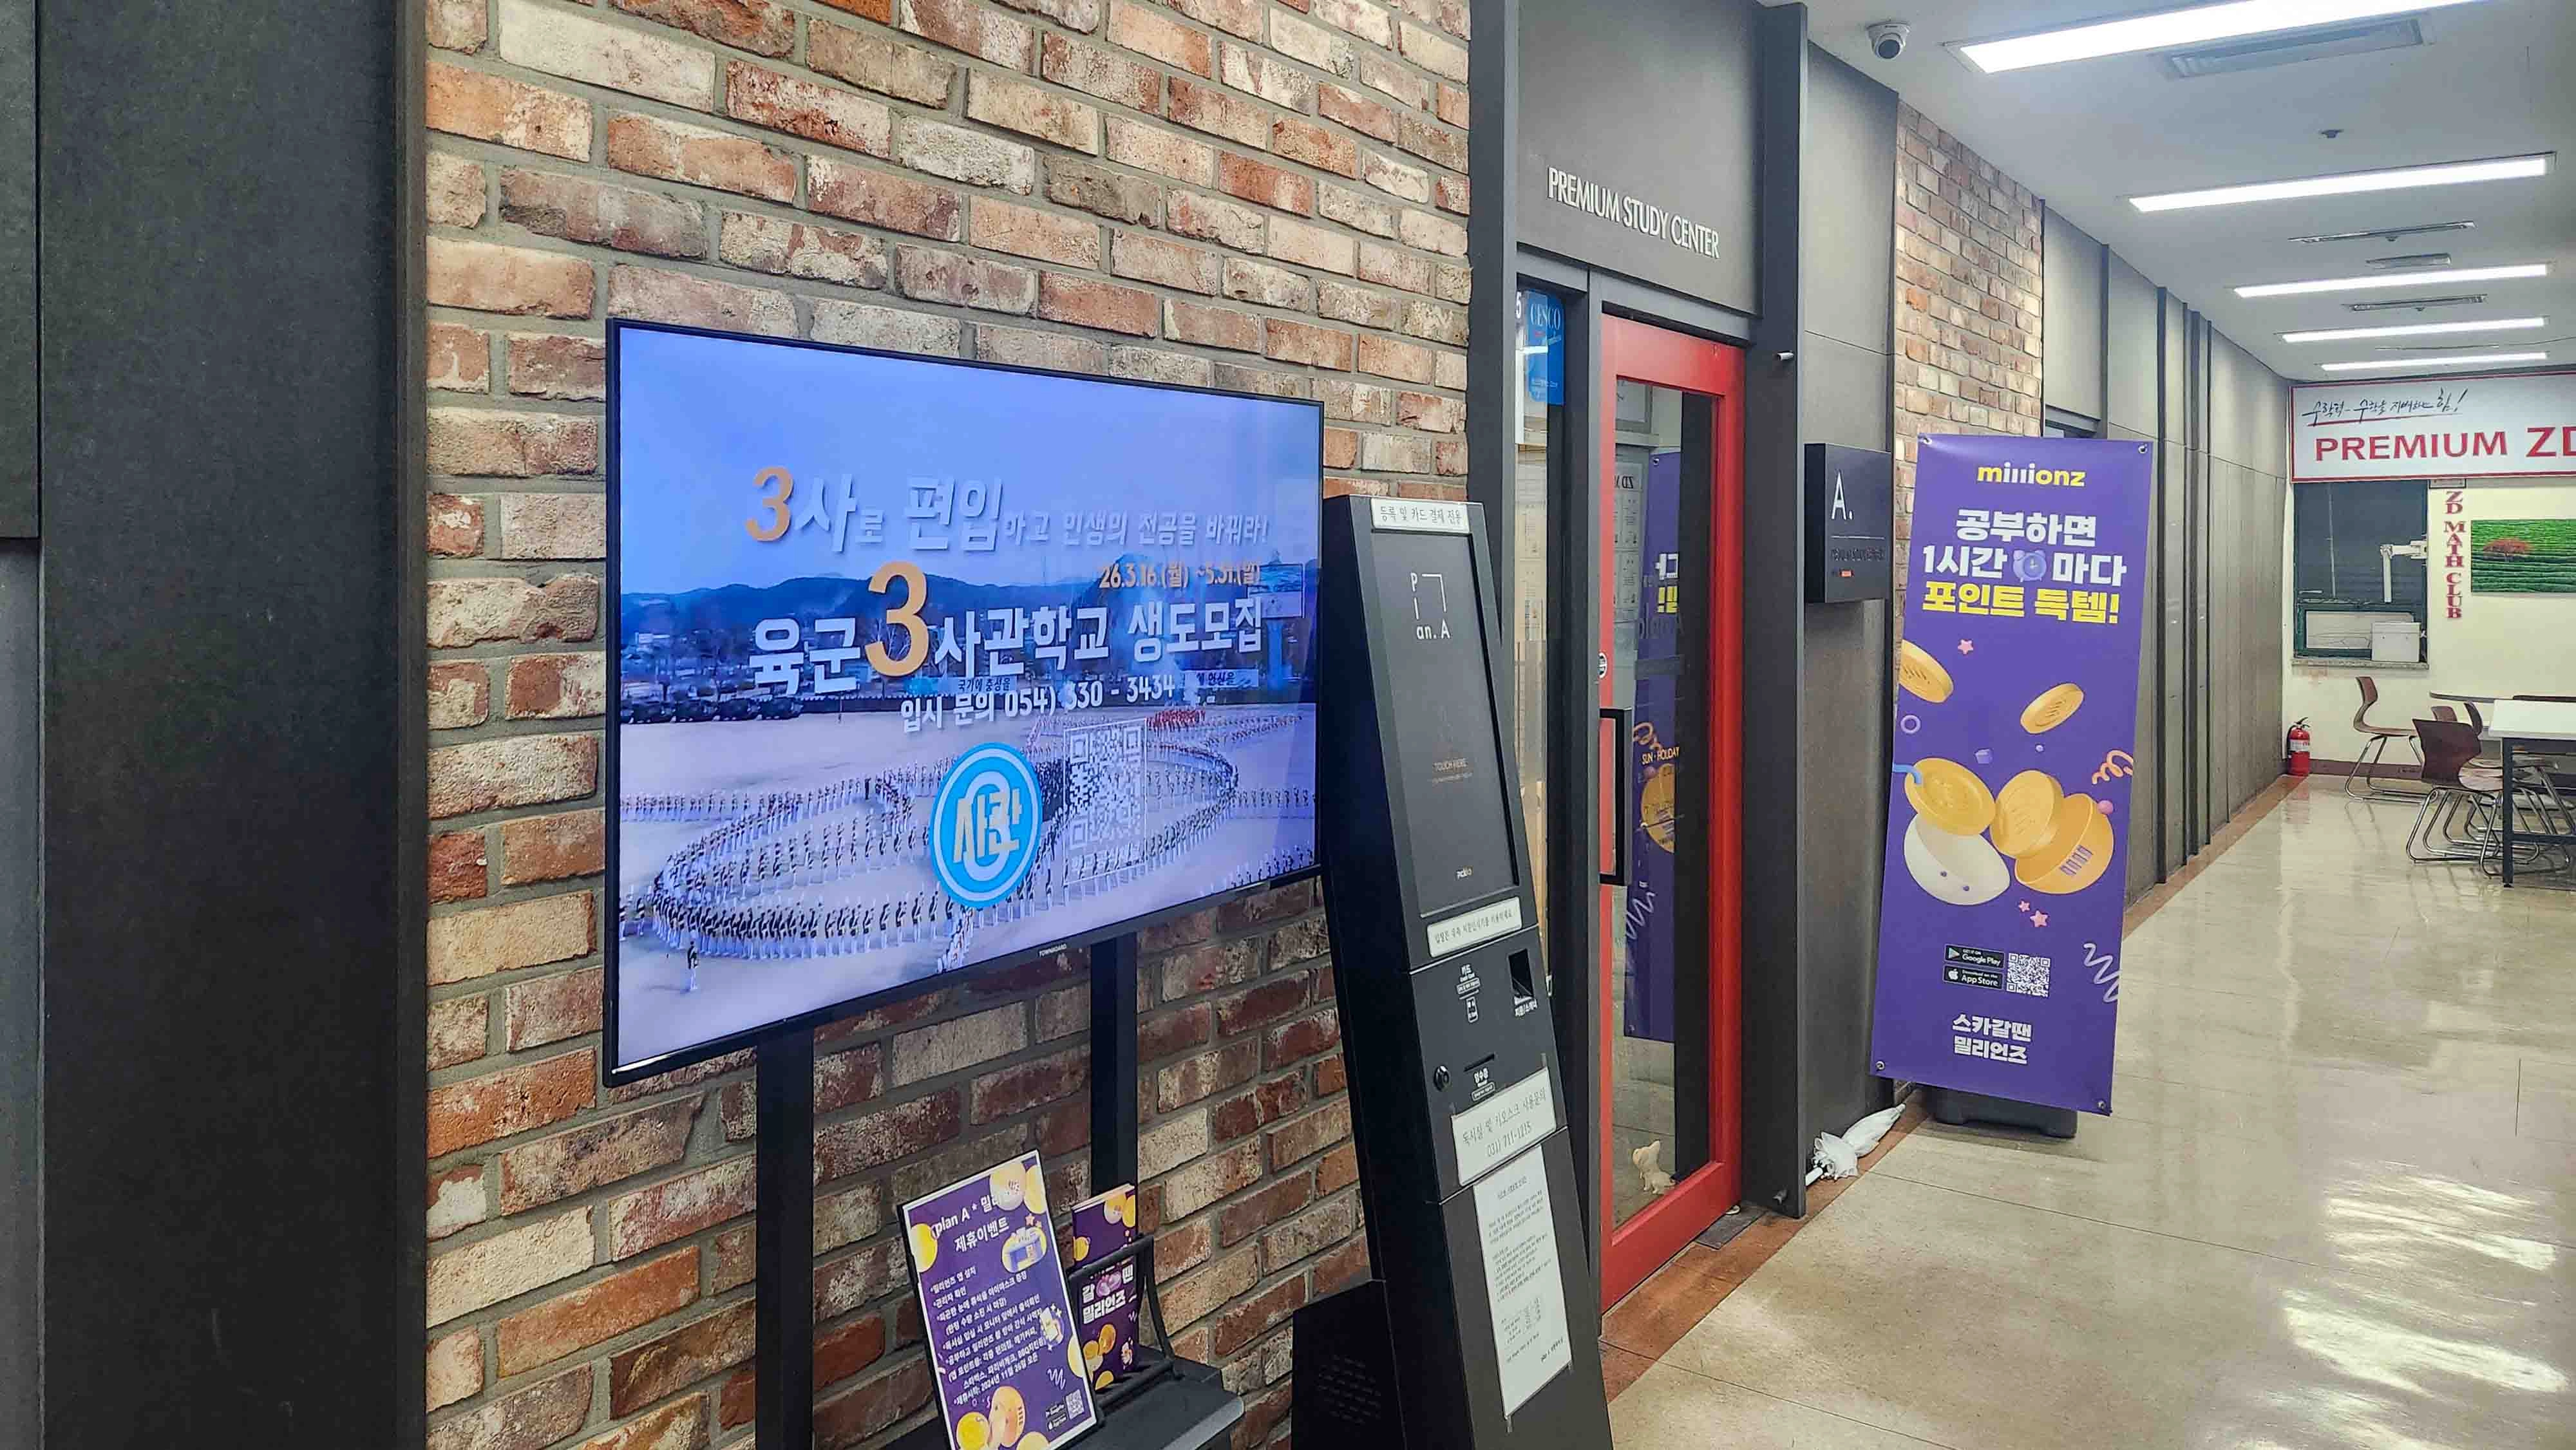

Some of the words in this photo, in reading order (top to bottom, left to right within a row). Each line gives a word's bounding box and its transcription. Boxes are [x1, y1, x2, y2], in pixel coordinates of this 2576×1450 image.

[1548, 165, 1620, 222] PREMIUM
[1623, 196, 1669, 240] STUDY
[1671, 214, 1720, 259] CENTER
[2315, 431, 2508, 463] PREMIUM
[744, 465, 885, 553] 3사로
[904, 477, 1051, 552] 편입하고
[1063, 509, 1130, 547] 인생의
[1830, 471, 1853, 520] A.
[2445, 491, 2463, 514] ZD
[1956, 508, 2097, 548] 공부하면
[1922, 544, 2007, 579] 1시간
[2052, 552, 2127, 587] 마다
[1922, 580, 2025, 617] 포인트
[2034, 587, 2120, 624] 득템!
[2445, 572, 2463, 619] CLUB
[749, 560, 1110, 696] 육군3사관학교
[1128, 596, 1263, 663] 생도모집
[901, 695, 942, 733] 입시
[954, 691, 995, 726] 문의
[1005, 686, 1056, 717] 054)
[1128, 673, 1175, 702] 3434
[1962, 953, 1986, 963] Google
[1987, 956, 2001, 966] Play
[1961, 974, 1977, 984] App
[1978, 976, 1998, 986] Store
[1954, 1035, 2027, 1064] 밀리언즈
[934, 1214, 958, 1239] plan
[961, 1207, 971, 1223] A
[954, 1217, 1010, 1252] 제휴이벤트
[1082, 1288, 1126, 1325] 밀리언즈
